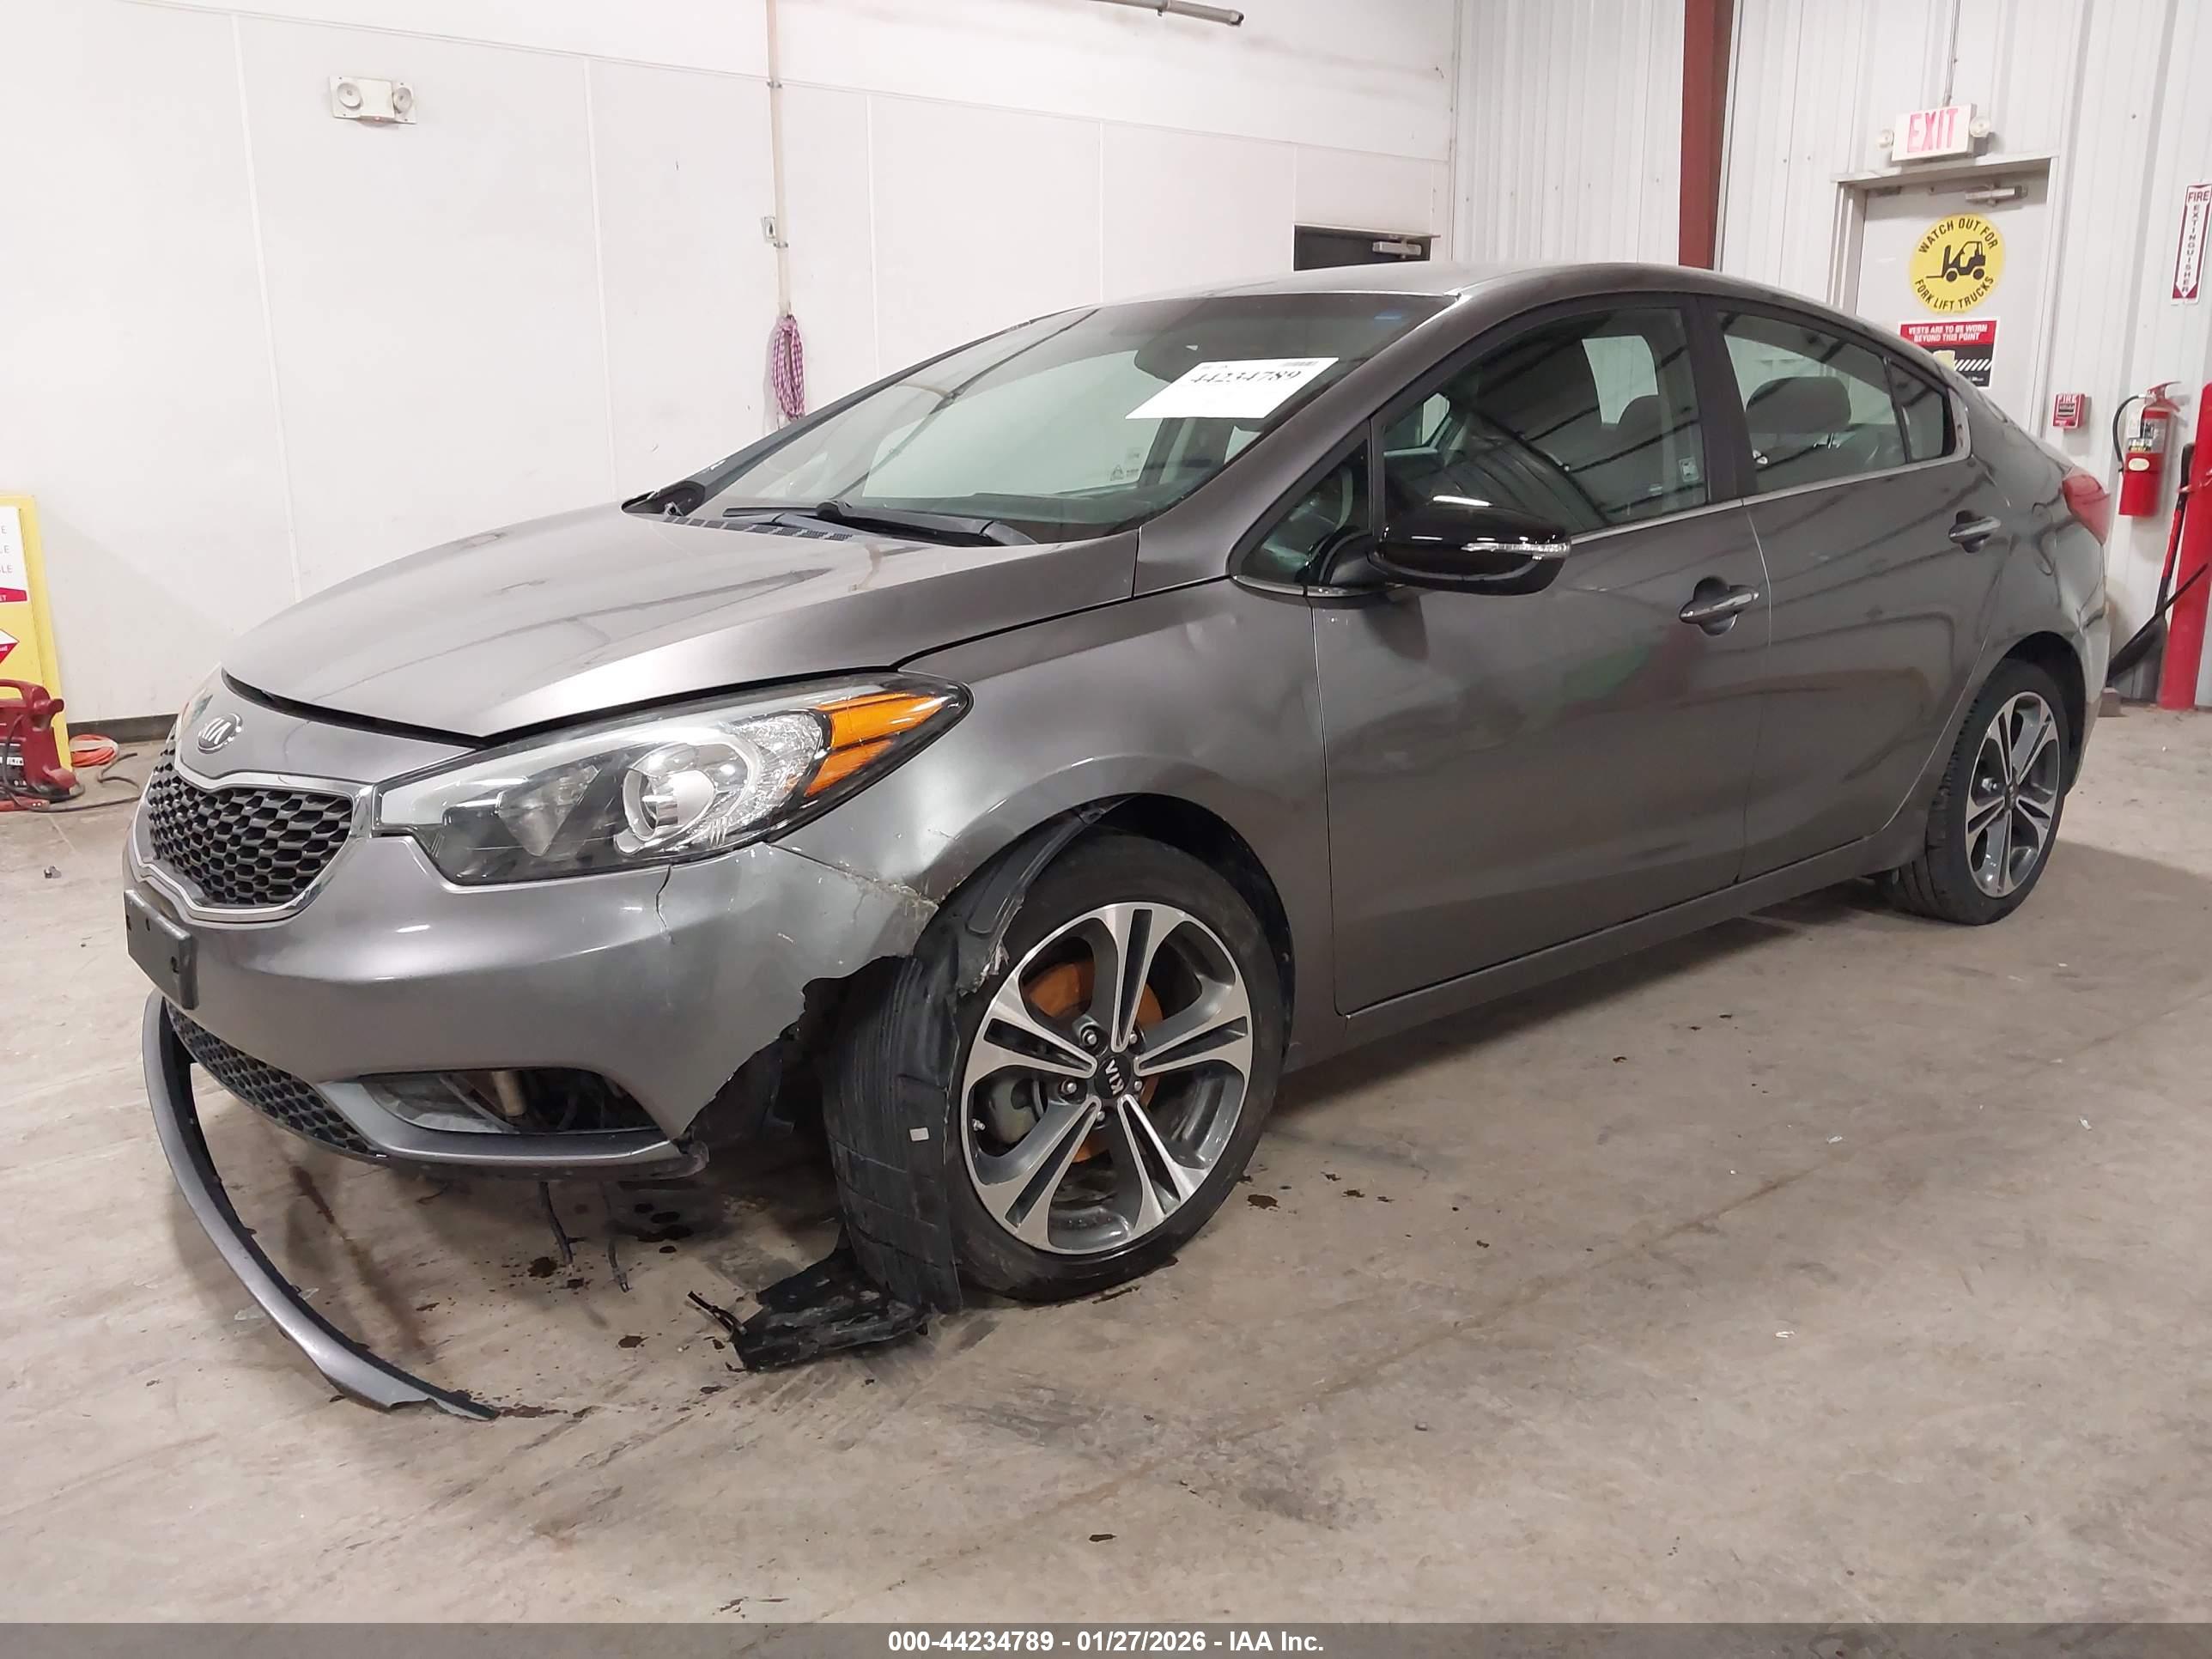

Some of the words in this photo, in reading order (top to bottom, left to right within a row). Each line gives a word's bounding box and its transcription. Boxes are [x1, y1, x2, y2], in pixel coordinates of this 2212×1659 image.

[1907, 107, 1959, 153] EXIT
[2187, 190, 2210, 203] FIRE
[1917, 219, 1954, 254] WATCH
[1958, 217, 1981, 232] OUT
[1979, 226, 1999, 250] FOR
[2181, 204, 2200, 293] EXTINGUISHER
[1914, 278, 1936, 305] FORK
[1933, 297, 1955, 312] LIFT
[1957, 276, 1995, 310] TRUCKS
[1908, 326, 1930, 335] VESTS
[1929, 325, 1943, 334] ARE
[1954, 325, 1965, 333] BE
[1965, 324, 1988, 333] WORN
[1913, 334, 1942, 343] BEYOND
[1942, 333, 1958, 342] THIS
[1958, 332, 1980, 341] POINT
[1190, 370, 1302, 383] 44234789
[2057, 392, 2075, 404] FIRE
[1105, 1058, 1125, 1096] KIA
